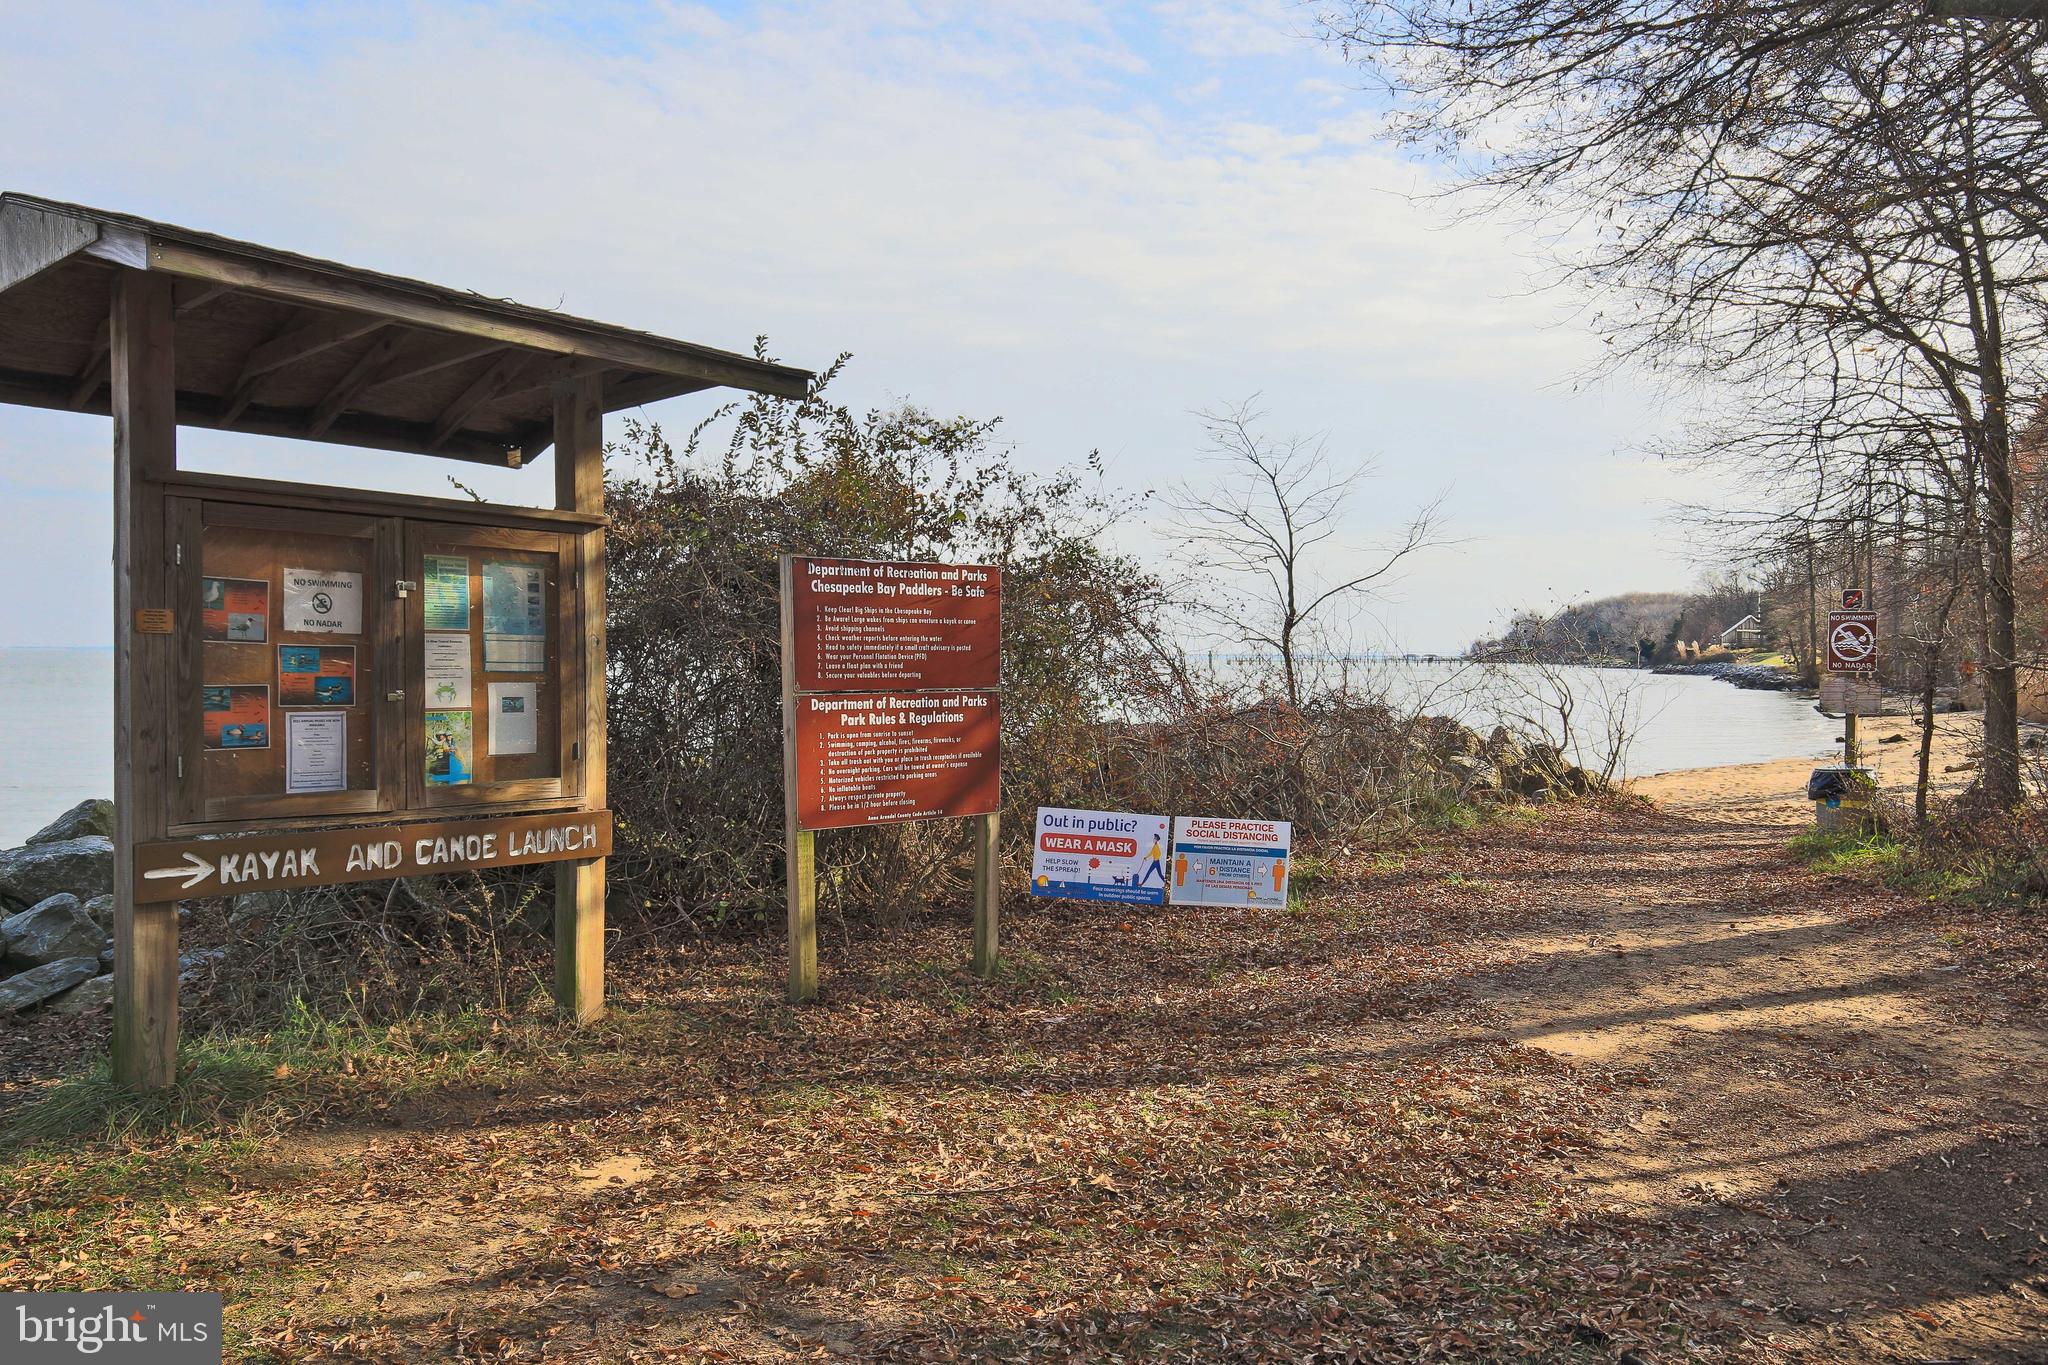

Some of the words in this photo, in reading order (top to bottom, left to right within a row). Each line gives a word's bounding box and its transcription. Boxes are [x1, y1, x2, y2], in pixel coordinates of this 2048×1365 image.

[808, 563, 870, 578] Department
[874, 565, 884, 577] of
[887, 566, 938, 580] Recreation
[941, 570, 959, 581] and
[962, 570, 987, 582] Parks
[294, 578, 306, 586] NO
[308, 580, 352, 589] SWIMMING
[811, 581, 873, 595] Chesapeake
[877, 582, 896, 597] Bay
[900, 584, 942, 596] Paddlers
[952, 586, 962, 597] Be
[966, 586, 984, 597] Safe
[304, 619, 314, 627] NO
[316, 620, 342, 628] NADAR
[811, 698, 873, 714] Department
[877, 697, 886, 709] of
[890, 697, 939, 709] Recreation
[943, 697, 959, 707] and
[962, 695, 987, 707] Parks
[841, 715, 865, 726] Park
[869, 713, 895, 725] Rules
[899, 713, 906, 724] &
[909, 712, 963, 726] Regulations
[1044, 815, 1068, 827] Out
[1073, 816, 1084, 828] in
[1089, 817, 1137, 833] public?
[1192, 820, 1226, 829] PLEASE
[1229, 822, 1273, 832] PRACTICE
[1186, 830, 1220, 839] SOCIAL
[1223, 832, 1278, 842] DISTANCING
[1046, 837, 1081, 849] WEAR
[1084, 840, 1092, 850] A
[1096, 840, 1133, 853] MASK
[221, 848, 320, 884] KAYAK
[347, 841, 402, 872] AND
[415, 833, 498, 865] CANOE
[508, 824, 597, 856] LAUNCH
[1210, 858, 1243, 866] MAINTAIN
[1219, 866, 1251, 874] DISTANCE
